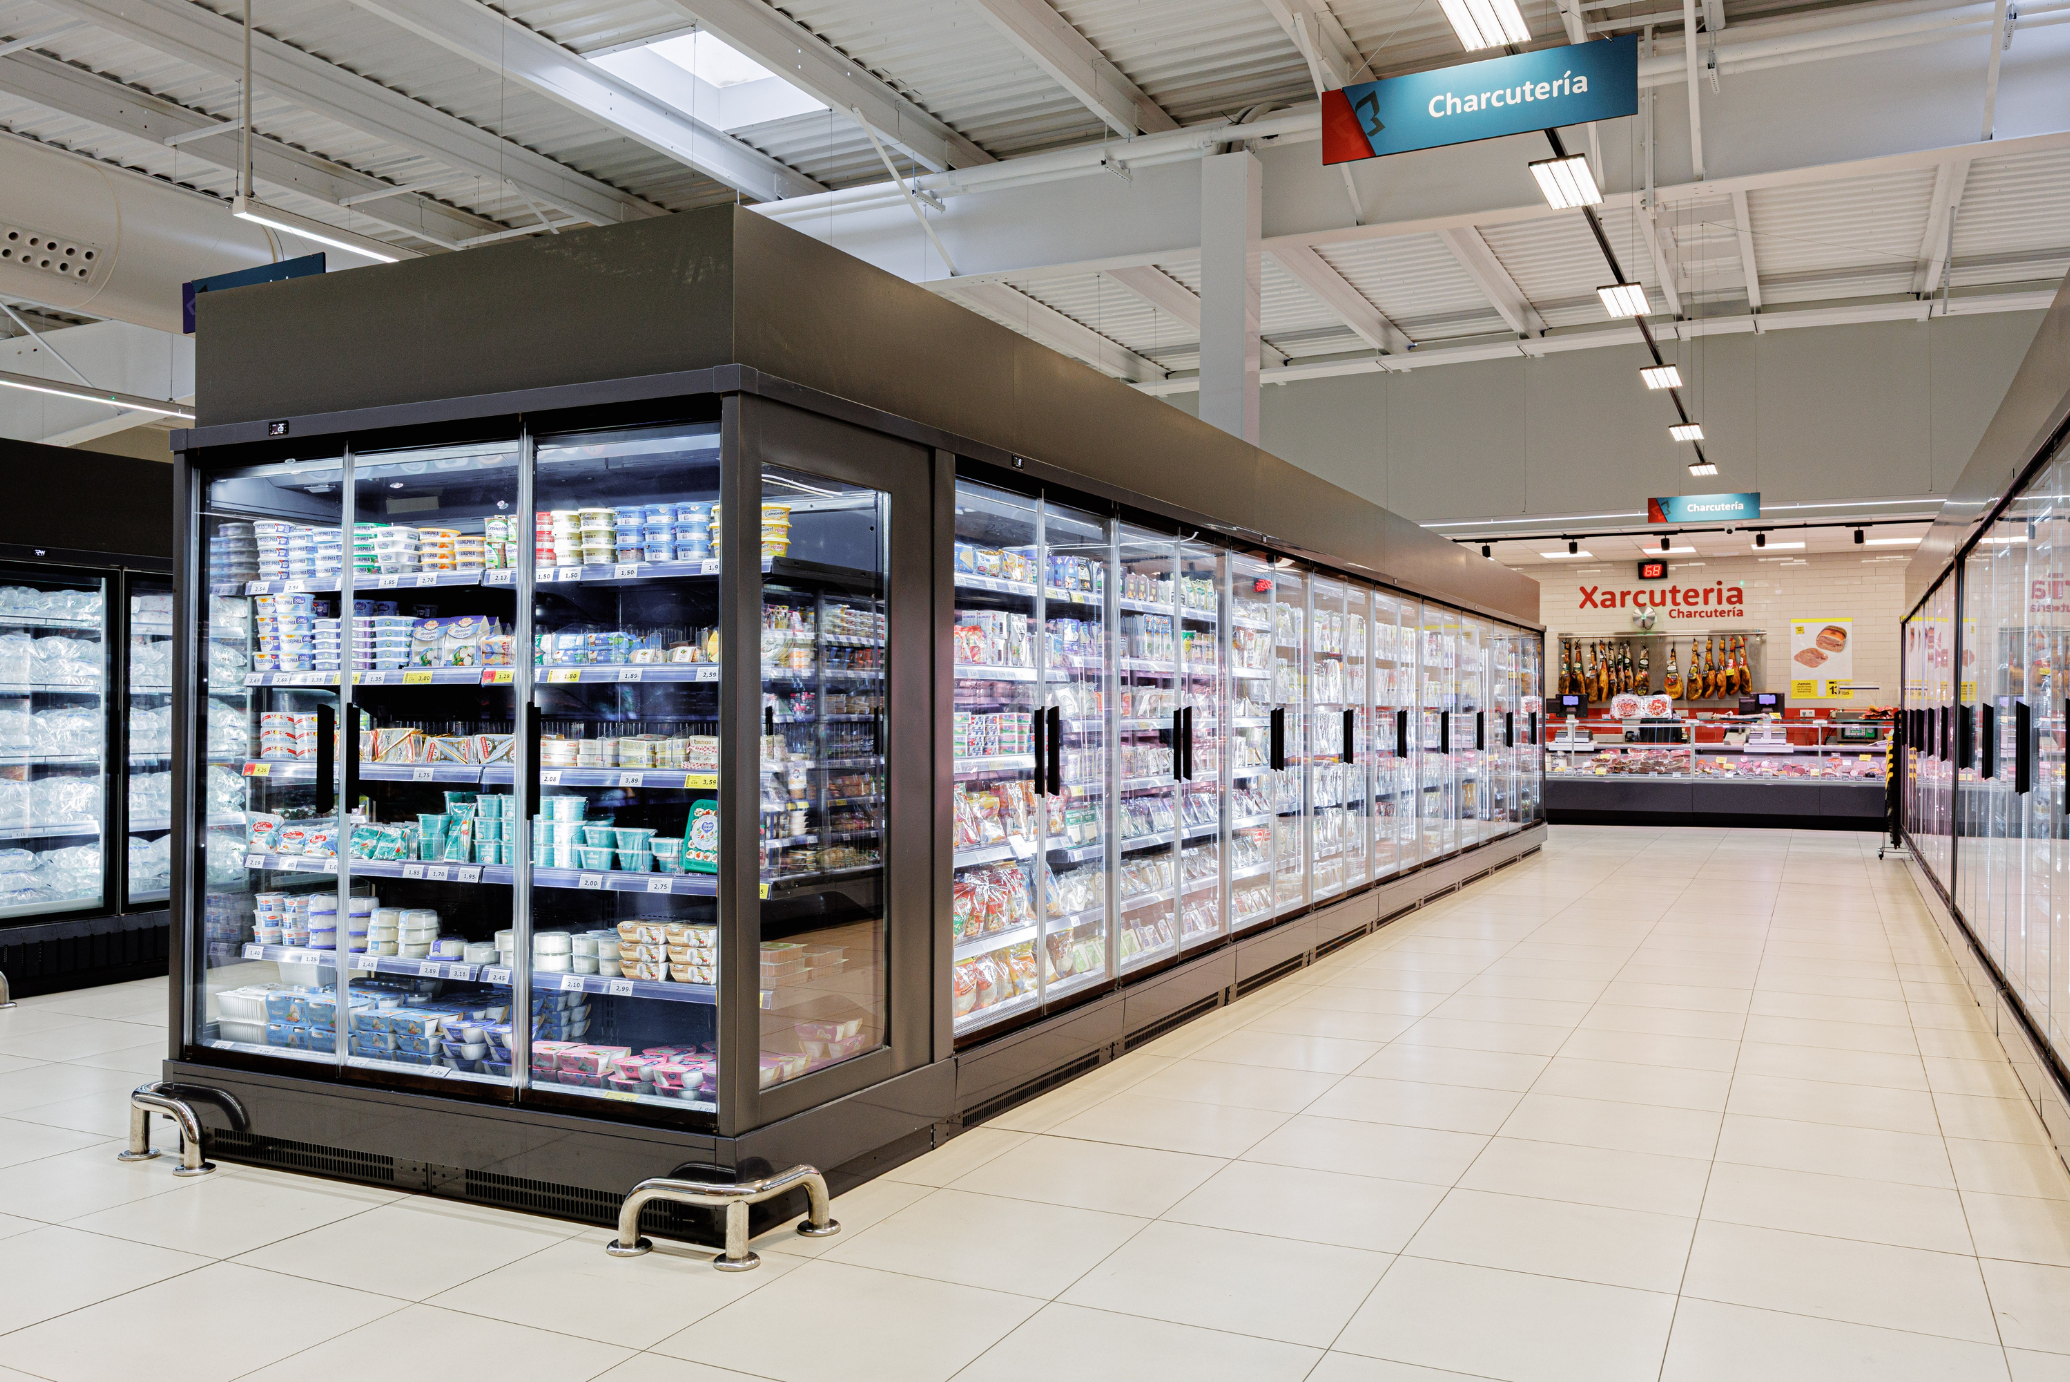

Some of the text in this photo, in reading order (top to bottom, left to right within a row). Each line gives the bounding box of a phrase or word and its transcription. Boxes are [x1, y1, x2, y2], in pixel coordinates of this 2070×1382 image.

[1428, 70, 1589, 118] Charcutería
[1687, 501, 1744, 512] Charcutería
[1644, 565, 1661, 577] 68
[1579, 581, 1743, 609] Xarcuteria
[1669, 607, 1743, 618] Charcutería
